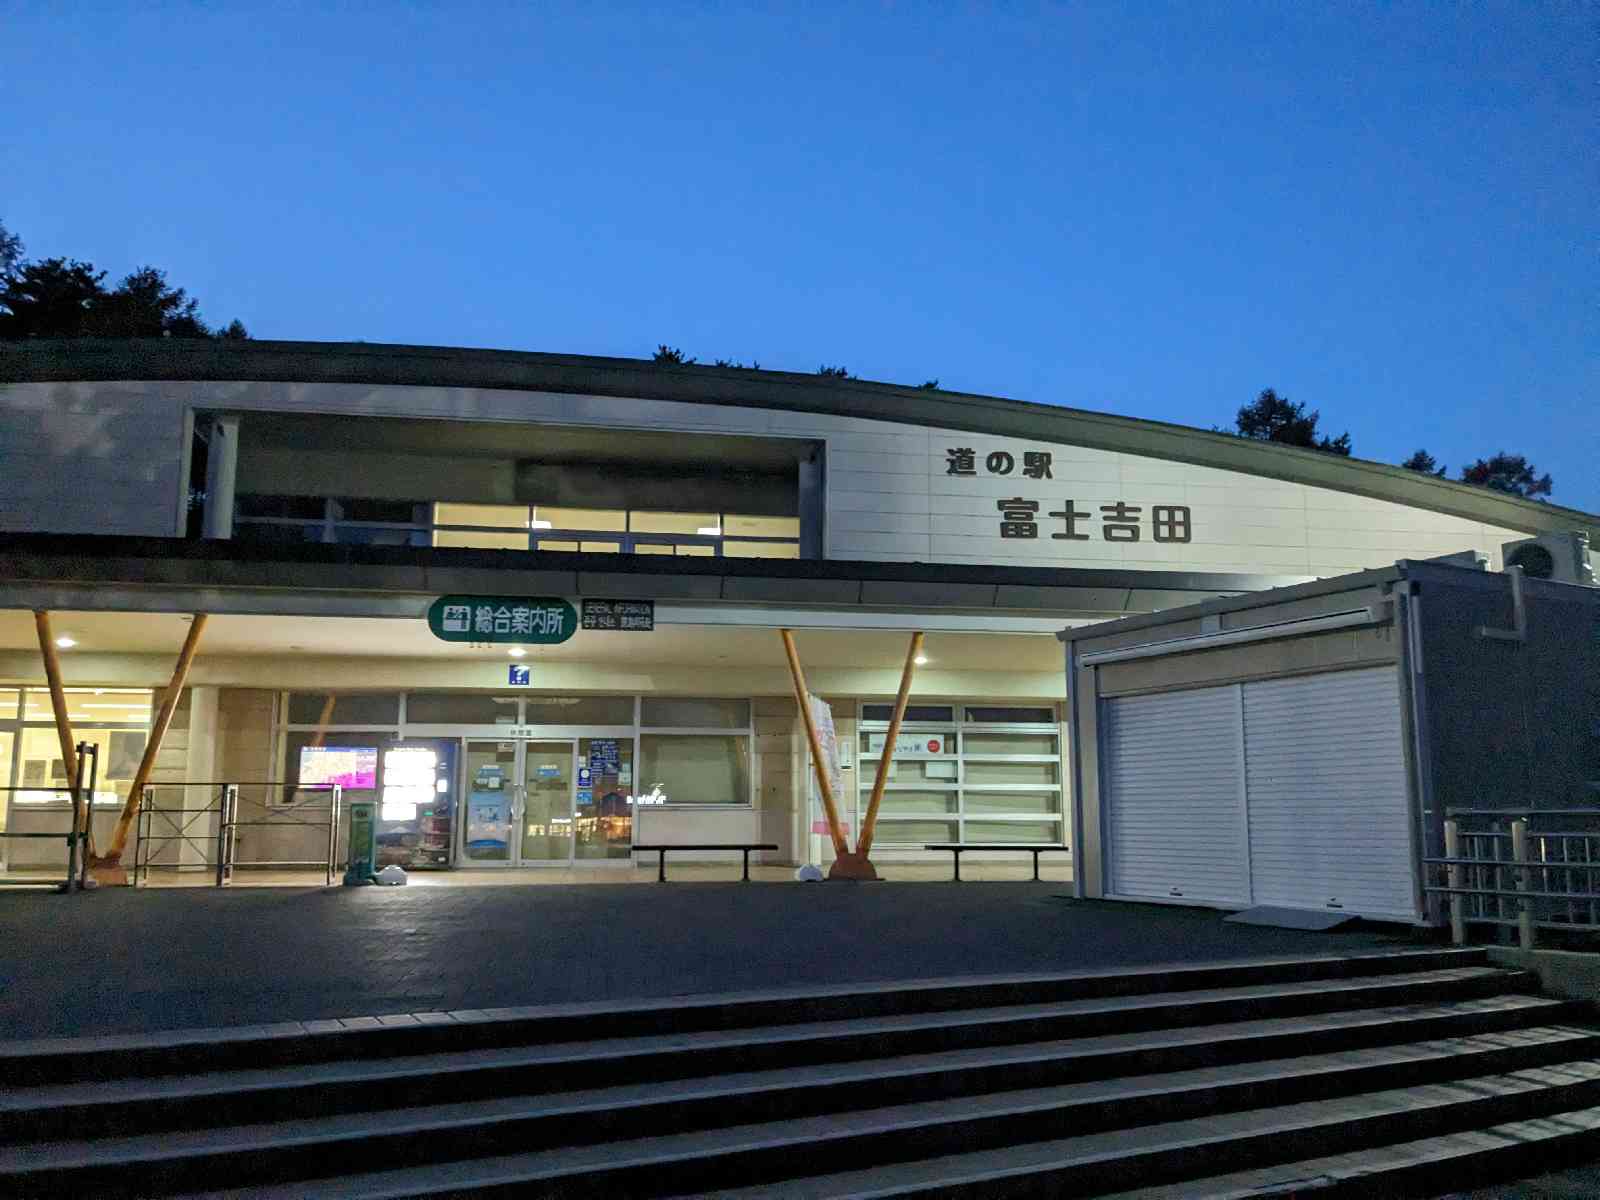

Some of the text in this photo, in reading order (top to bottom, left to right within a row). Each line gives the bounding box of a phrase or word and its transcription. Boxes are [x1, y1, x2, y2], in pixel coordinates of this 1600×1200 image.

[946, 447, 1053, 479] 道の駅
[997, 497, 1192, 543] 富士吉田
[475, 605, 564, 634] 総合案内所
